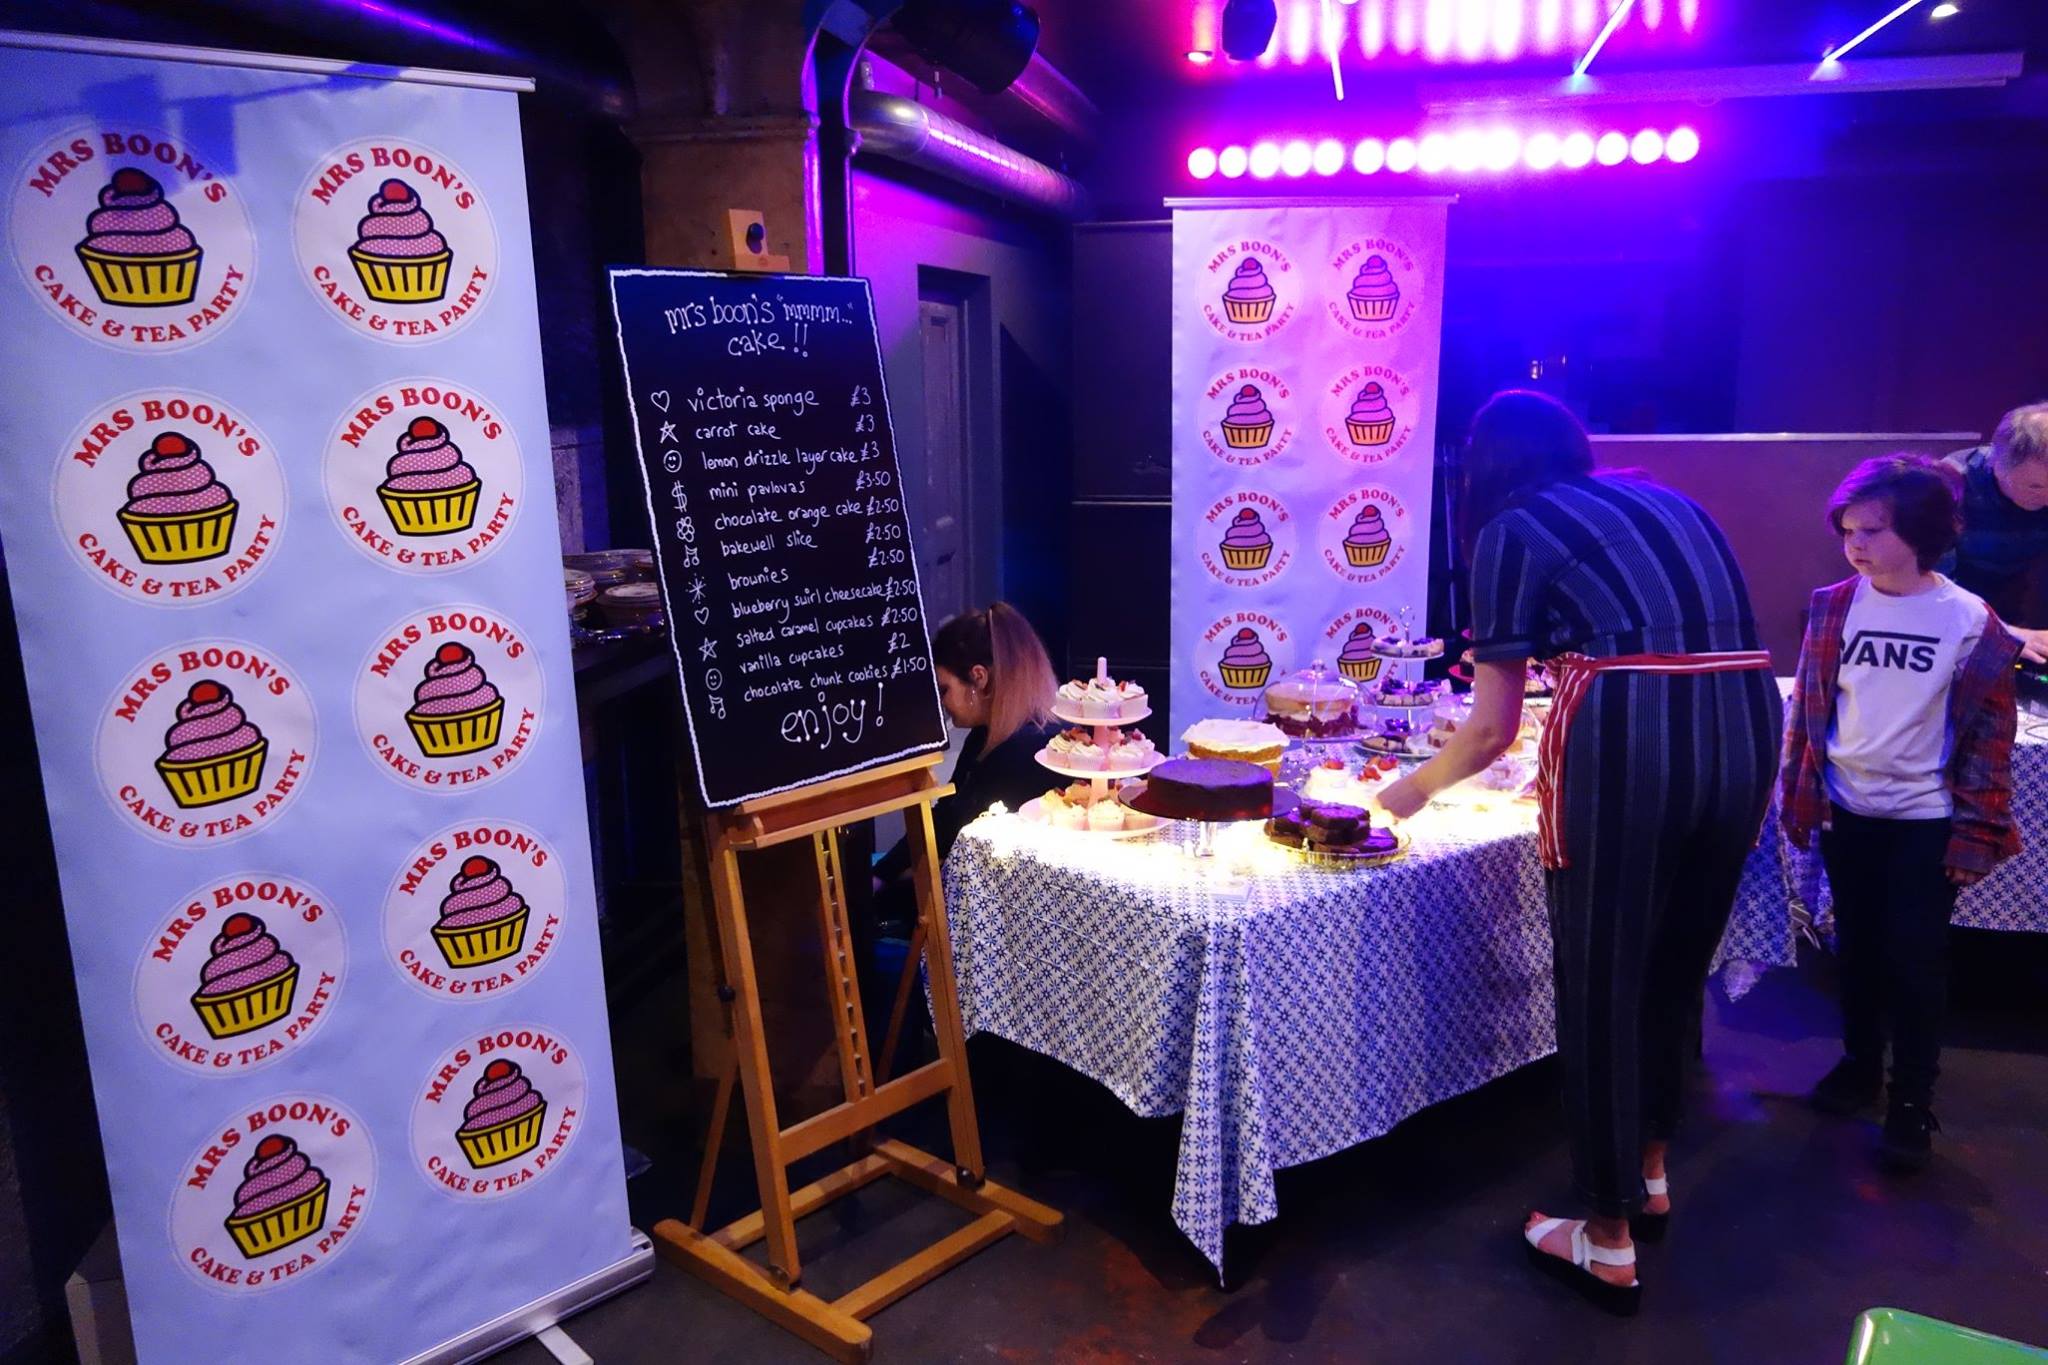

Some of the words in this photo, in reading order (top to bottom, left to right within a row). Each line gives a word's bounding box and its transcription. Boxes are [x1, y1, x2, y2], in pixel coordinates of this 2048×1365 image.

[30, 139, 94, 197] MRS
[102, 133, 227, 203] BOON'S
[312, 153, 364, 206] MRS
[370, 147, 475, 210] BOON'S
[1208, 245, 1236, 273] MRS
[1241, 241, 1291, 272] BOON'S
[34, 265, 97, 326] CAKE
[102, 319, 124, 337] &
[131, 324, 186, 342] TEA
[187, 265, 244, 331] PARTY
[314, 266, 366, 321] CAKE
[368, 315, 387, 330] &
[393, 320, 437, 336] TEA
[439, 266, 487, 326] PARTY
[665, 302, 706, 334] mrs
[710, 294, 775, 325] boon's
[1204, 304, 1225, 333] CAKE
[1227, 329, 1236, 340] &
[1239, 332, 1262, 341] TEA
[1265, 303, 1294, 335] PARTY
[688, 386, 758, 412] victoria
[763, 391, 819, 416] sponge
[850, 385, 871, 407] £3
[1207, 372, 1235, 400] MRS
[1240, 369, 1290, 399] BOON'S
[1331, 370, 1359, 397] MRS
[74, 409, 134, 468] MRS
[142, 399, 260, 457] BOON'S
[341, 396, 394, 448] MRS
[400, 387, 502, 440] BOON'S
[696, 421, 738, 439] carrot
[748, 422, 781, 439] cake
[855, 414, 875, 433] £3
[702, 451, 738, 470] lemon
[744, 449, 791, 466] drizzle
[796, 448, 827, 475] layer
[830, 447, 858, 463] cake
[860, 441, 880, 462] £3
[1203, 430, 1224, 458] CAKE
[1226, 454, 1235, 464] &
[1238, 456, 1261, 466] TEA
[1264, 429, 1292, 460] PARTY
[1326, 427, 1347, 456] CAKE
[1362, 453, 1383, 463] TEA
[1384, 426, 1411, 457] PARTY
[709, 482, 739, 500] mini
[747, 481, 805, 503] pavlovas
[1206, 496, 1233, 523] MRS
[1238, 492, 1289, 523] BOON'S
[1329, 493, 1357, 520] MRS
[1362, 489, 1405, 518] BOON'S
[343, 507, 394, 556] CAKE
[397, 548, 415, 563] &
[421, 548, 466, 566] TEA
[468, 492, 514, 554] PARTY
[715, 507, 782, 530] chocolate
[788, 505, 830, 527] orange
[836, 499, 863, 516] cake
[79, 534, 138, 587] CAKE
[142, 579, 163, 594] &
[169, 577, 221, 597] TEA
[223, 514, 275, 582] PARTY
[720, 534, 775, 557] bakewell
[786, 530, 818, 548] slice
[728, 566, 789, 591] brownies
[1201, 552, 1223, 580] CAKE
[1225, 575, 1234, 585] &
[1237, 578, 1260, 587] TEA
[1262, 551, 1290, 582] PARTY
[1325, 549, 1346, 576] CAKE
[1348, 573, 1355, 582] &
[1358, 573, 1376, 583] TEA
[1379, 545, 1405, 577] PARTY
[731, 598, 790, 624] blueberry
[825, 583, 886, 603] cheesecake
[1326, 613, 1352, 639] MRS
[1356, 608, 1398, 634] BOON'S
[371, 625, 421, 678] MRS
[427, 613, 524, 659] BOON'S
[781, 617, 819, 637] caramel
[825, 614, 874, 634] cupcakes
[1205, 616, 1232, 642] MRS
[1236, 612, 1287, 642] BOON'S
[739, 652, 782, 674] vanilla
[789, 644, 844, 667] cupcakes
[888, 632, 910, 654] £2
[115, 662, 172, 723] MRS
[178, 648, 290, 696] BOON'S
[744, 677, 803, 702] chocolate
[810, 672, 843, 688] chunk
[848, 664, 888, 682] cookies
[1200, 670, 1221, 698] CAKE
[1224, 694, 1233, 704] &
[373, 734, 420, 778] CAKE
[424, 770, 441, 784] &
[447, 766, 490, 785] TEA
[492, 708, 534, 769] PARTY
[120, 785, 175, 833] CAKE
[179, 823, 198, 837] &
[205, 814, 253, 837] TEA
[253, 749, 305, 817] PARTY
[399, 842, 447, 896] MRS
[453, 828, 548, 867] BOON'S
[153, 902, 207, 963] MRS
[213, 882, 323, 922] BOON'S
[400, 950, 446, 989] CAKE
[450, 980, 466, 993] &
[471, 973, 514, 993] TEA
[516, 914, 559, 975] PARTY
[156, 1023, 208, 1064] CAKE
[213, 1052, 232, 1067] &
[238, 1039, 284, 1065] TEA
[285, 972, 335, 1040] PARTY
[426, 1049, 471, 1104] MRS
[478, 1032, 568, 1065] BOON'S
[187, 1128, 241, 1190] MRS
[247, 1102, 350, 1137] BOON'S
[428, 1156, 469, 1192] CAKE
[473, 1180, 489, 1193] &
[494, 1168, 534, 1191] TEA
[535, 1107, 576, 1168] PARTY
[191, 1247, 242, 1284] CAKE
[246, 1270, 264, 1285] &
[270, 1253, 316, 1281] TEA
[317, 1184, 365, 1254] PARTY
